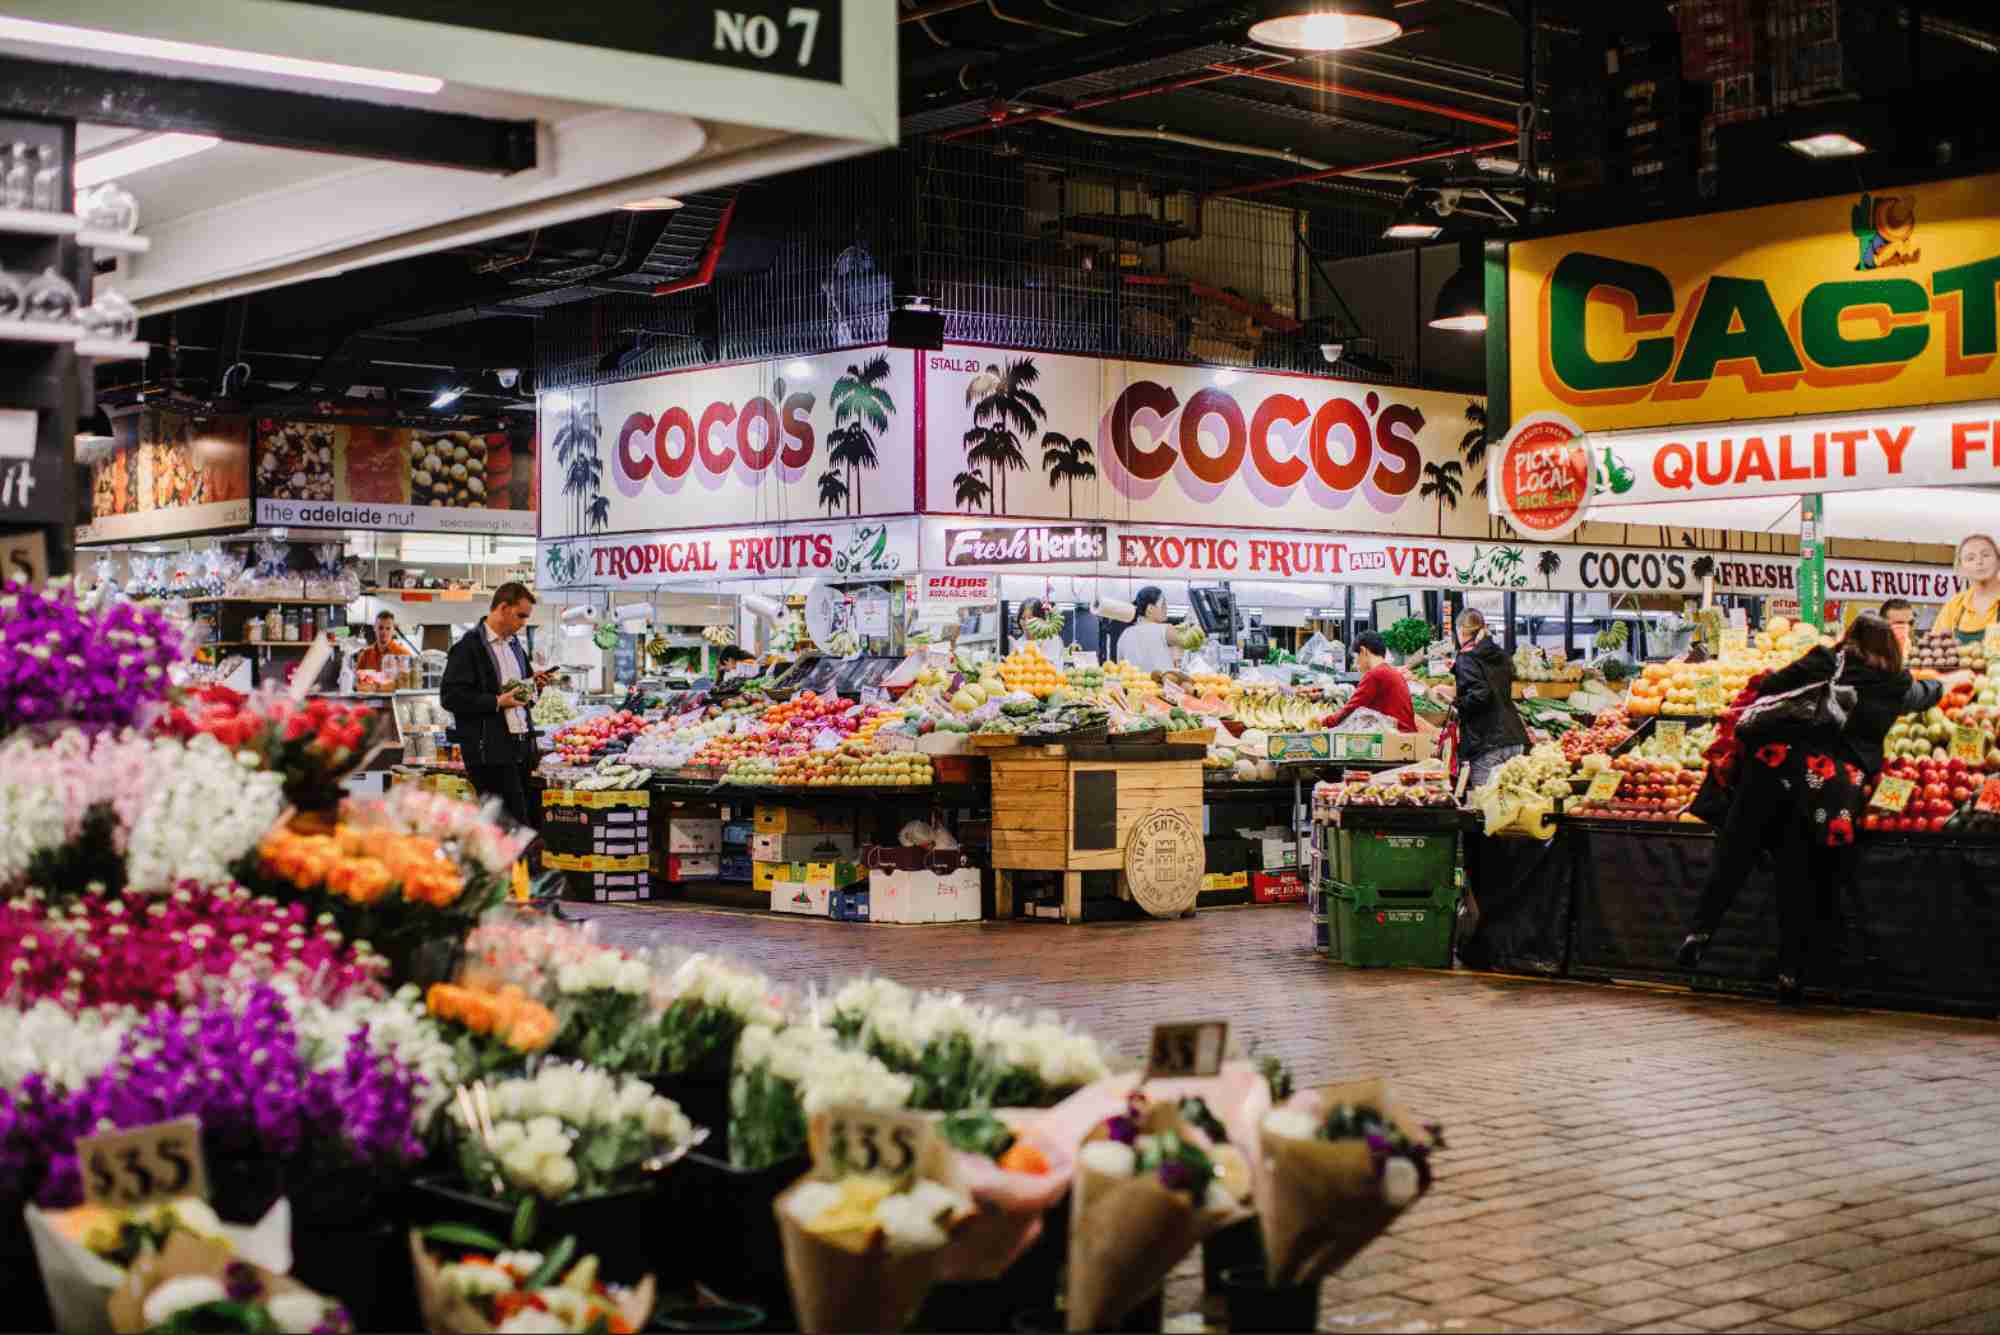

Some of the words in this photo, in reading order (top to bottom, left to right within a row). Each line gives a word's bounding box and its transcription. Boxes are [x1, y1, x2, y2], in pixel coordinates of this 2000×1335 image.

[712, 9, 779, 58] NO
[787, 7, 820, 67] 7
[1550, 251, 2000, 391] CACT
[930, 357, 963, 372] STALL
[965, 359, 981, 373] 20
[618, 377, 816, 481] COCO'S
[1111, 379, 1426, 496] COCO'S
[1652, 425, 1916, 491] QUALITY
[1516, 467, 1576, 497] LOCAL
[264, 502, 293, 521] the
[299, 505, 383, 525] adelaide
[387, 509, 415, 526] nut
[590, 539, 718, 581] TROPICAL
[950, 529, 1027, 566] Fresh
[1028, 527, 1104, 563] Herbs
[1118, 535, 1238, 570] EXOTIC
[1248, 539, 1348, 577] FRUIT
[1349, 551, 1386, 570] AND
[927, 575, 989, 588] eftpos
[1579, 551, 1687, 590] COCO'S
[1719, 561, 1794, 590] FRESH
[1870, 570, 1931, 597] FRUIT
[1933, 574, 1949, 598] &
[90, 1136, 189, 1203] $35
